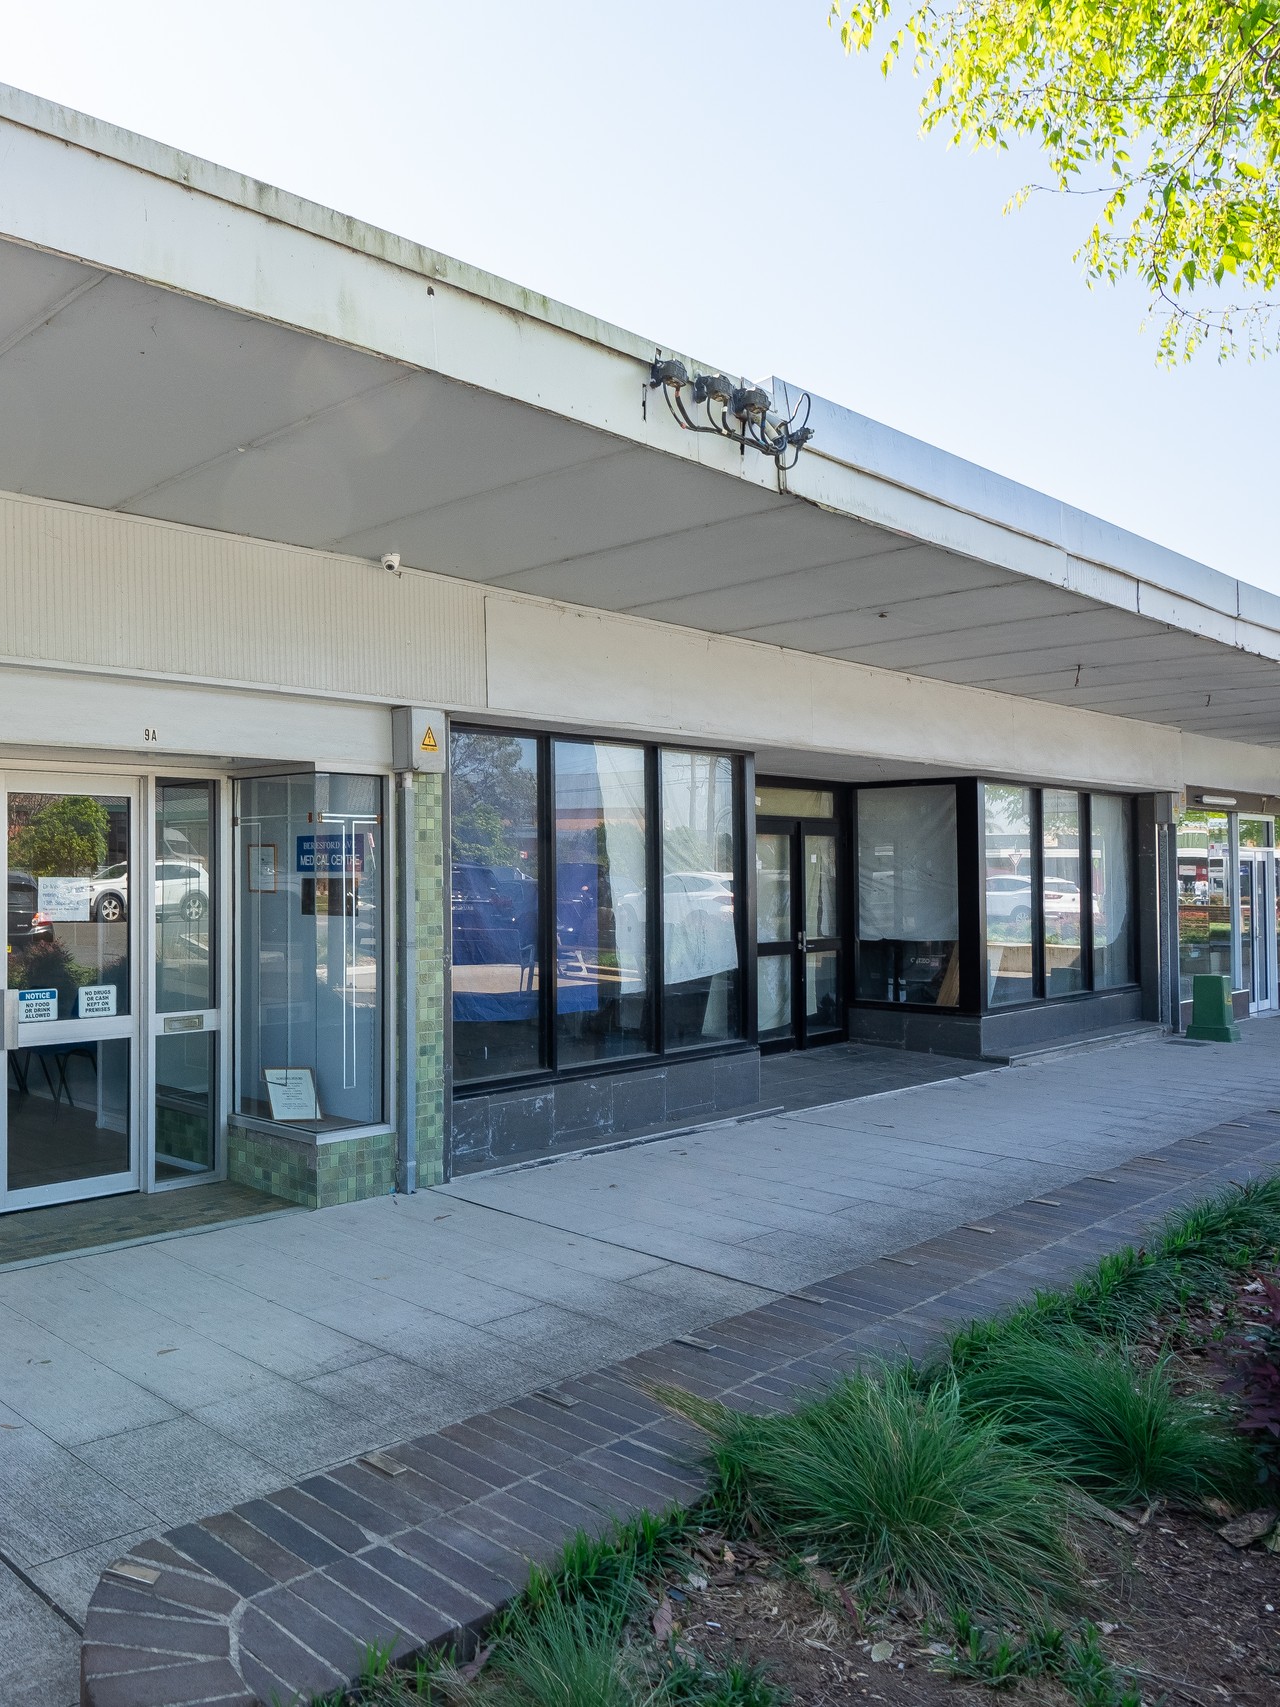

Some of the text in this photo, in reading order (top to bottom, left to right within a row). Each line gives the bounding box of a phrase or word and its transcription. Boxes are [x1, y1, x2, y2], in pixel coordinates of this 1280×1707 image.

[144, 728, 157, 741] 9A
[303, 841, 340, 849] BERESFORD
[300, 854, 329, 866] MEDCAL
[25, 991, 51, 1000] NOTICE
